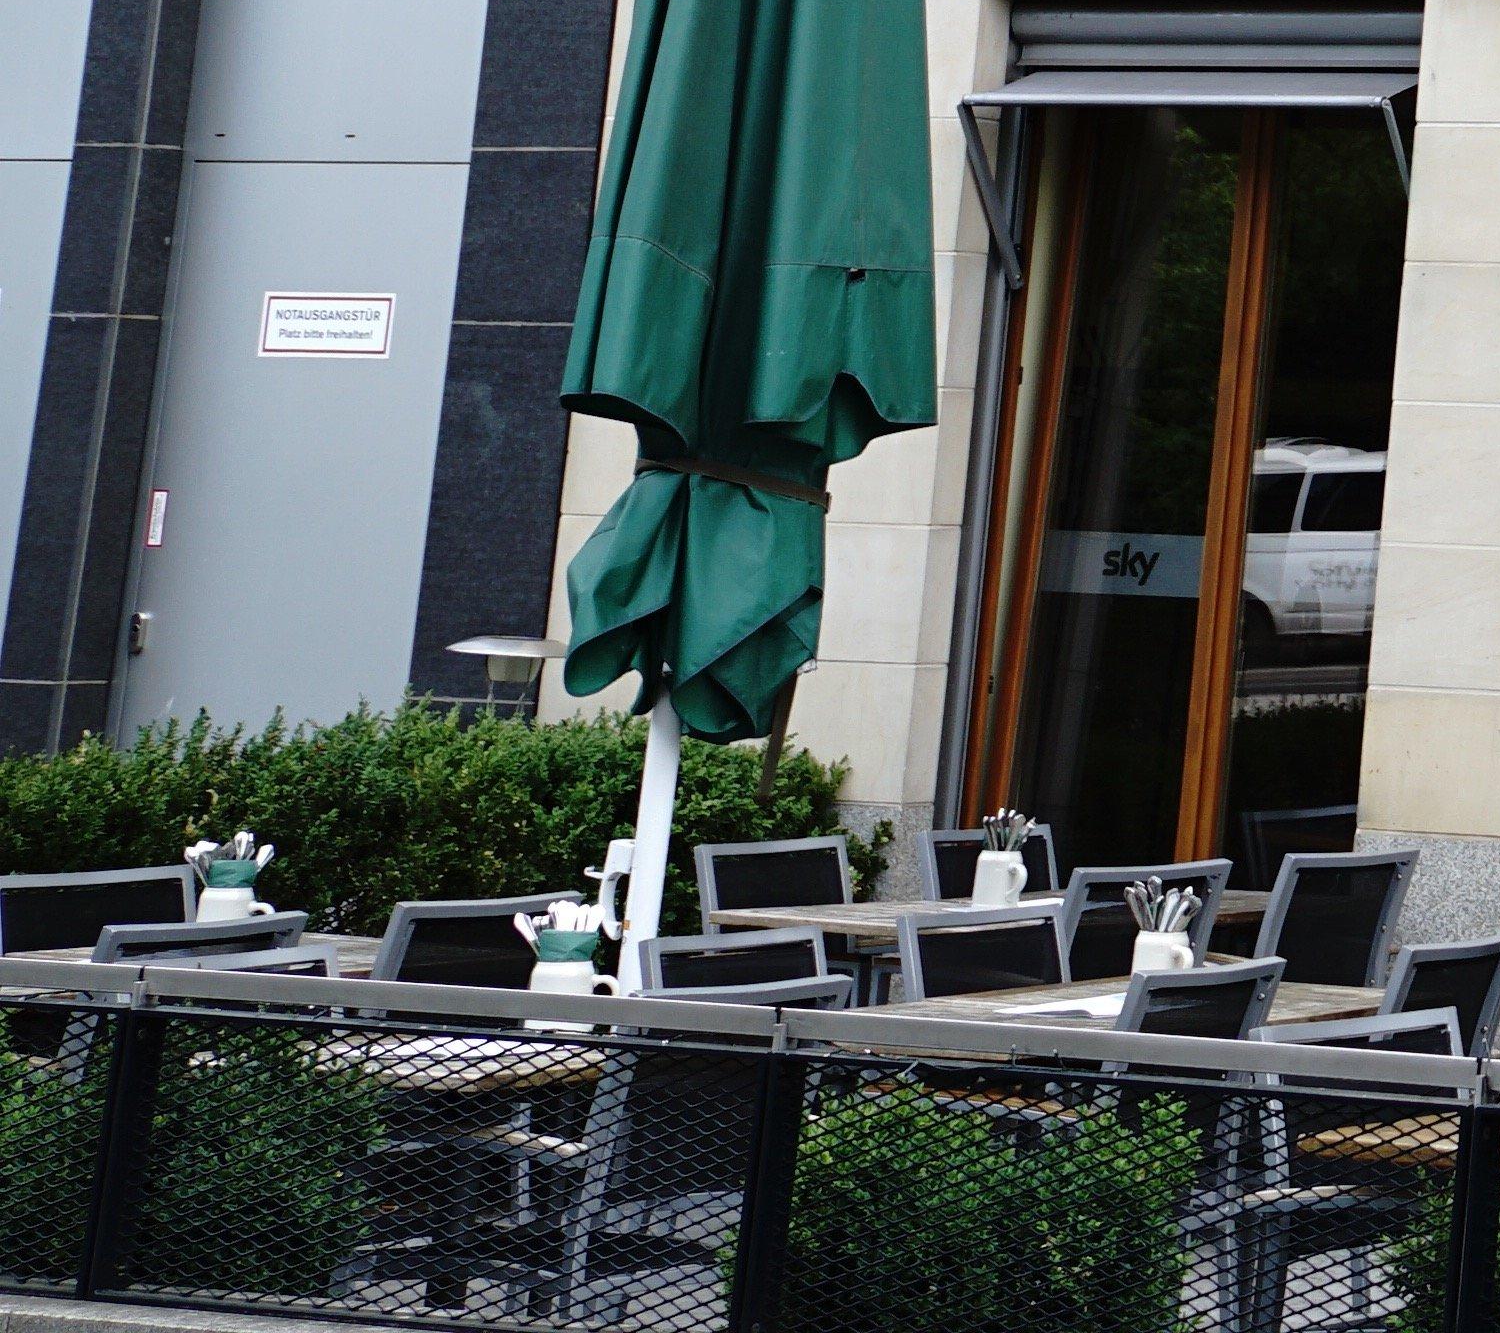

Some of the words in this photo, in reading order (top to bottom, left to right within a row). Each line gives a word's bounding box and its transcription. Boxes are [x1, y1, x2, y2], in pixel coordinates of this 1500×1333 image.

[275, 308, 381, 322] NOTAUSGANGSTÜR
[279, 328, 301, 339] Platz
[303, 328, 325, 339] bitte
[1102, 542, 1160, 586] sky
